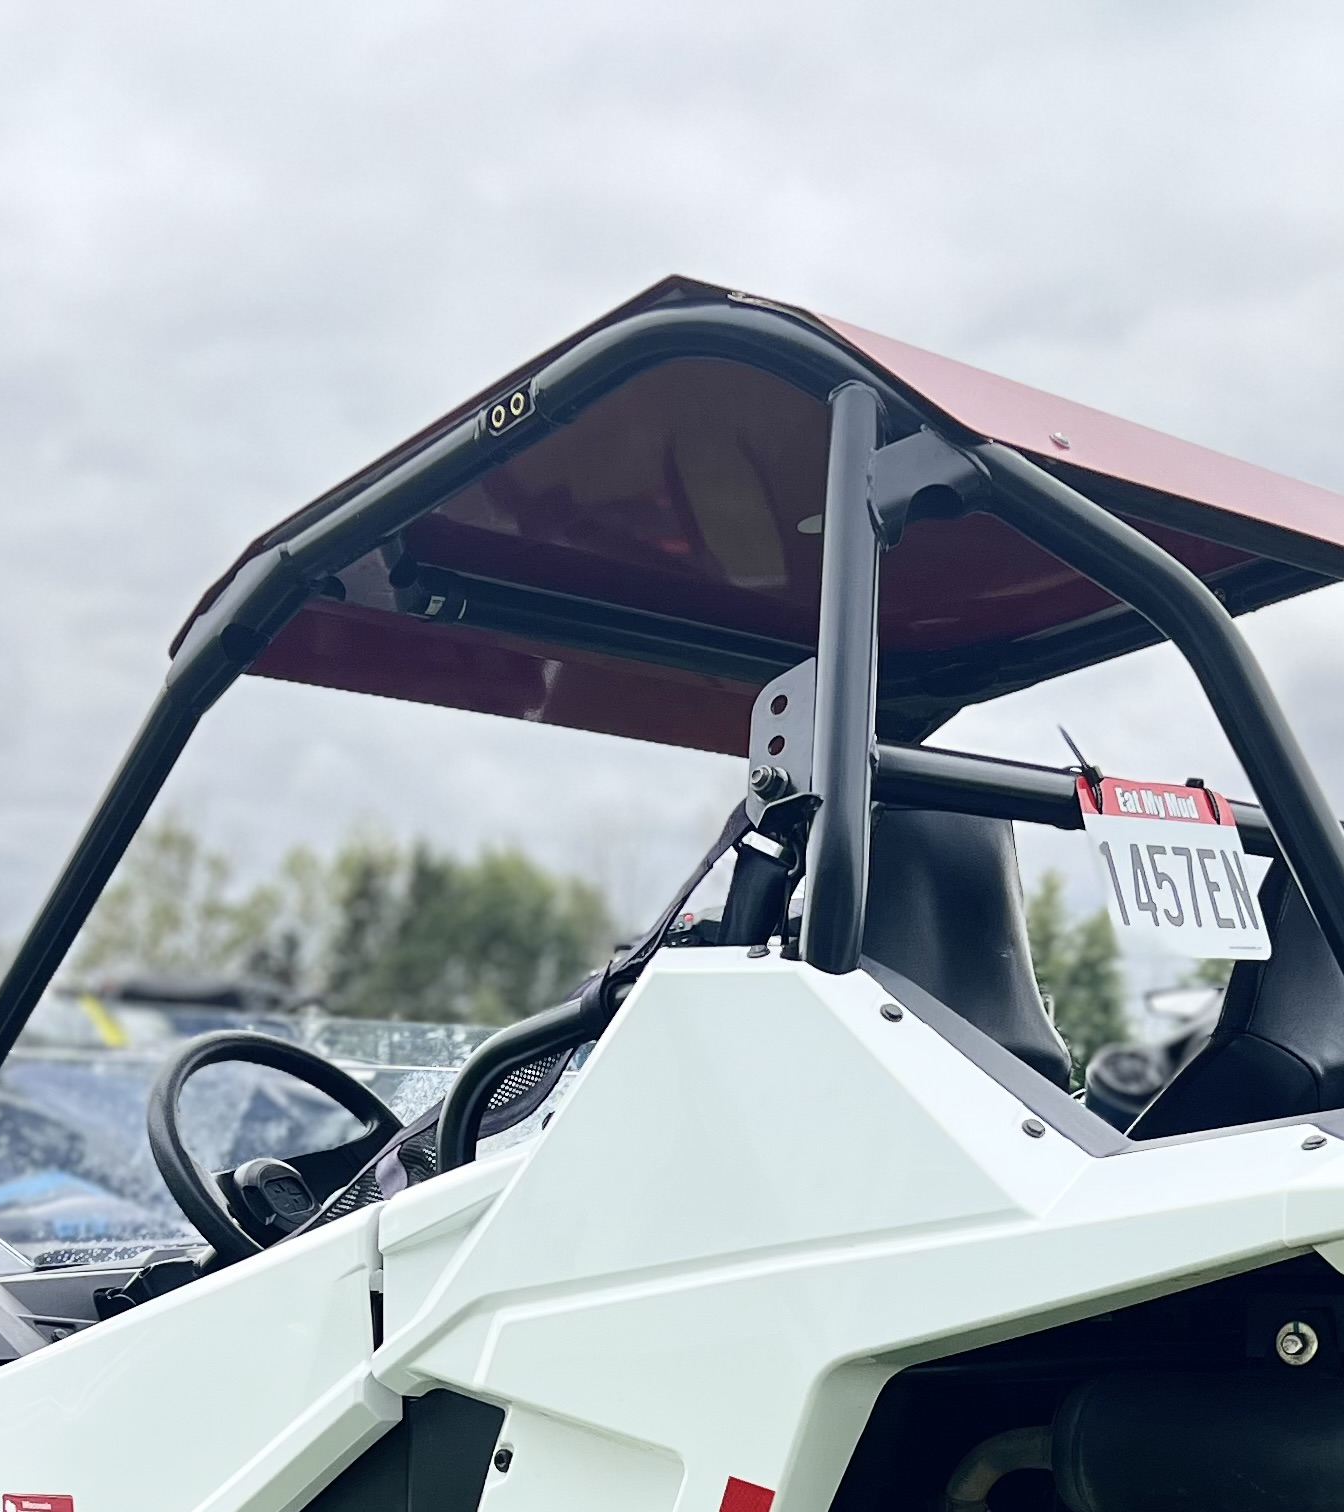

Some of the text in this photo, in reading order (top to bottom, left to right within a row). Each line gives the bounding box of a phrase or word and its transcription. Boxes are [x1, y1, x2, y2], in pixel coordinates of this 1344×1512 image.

[1114, 786, 1200, 820] Eat My Mud
[1098, 840, 1260, 930] 1457EN
